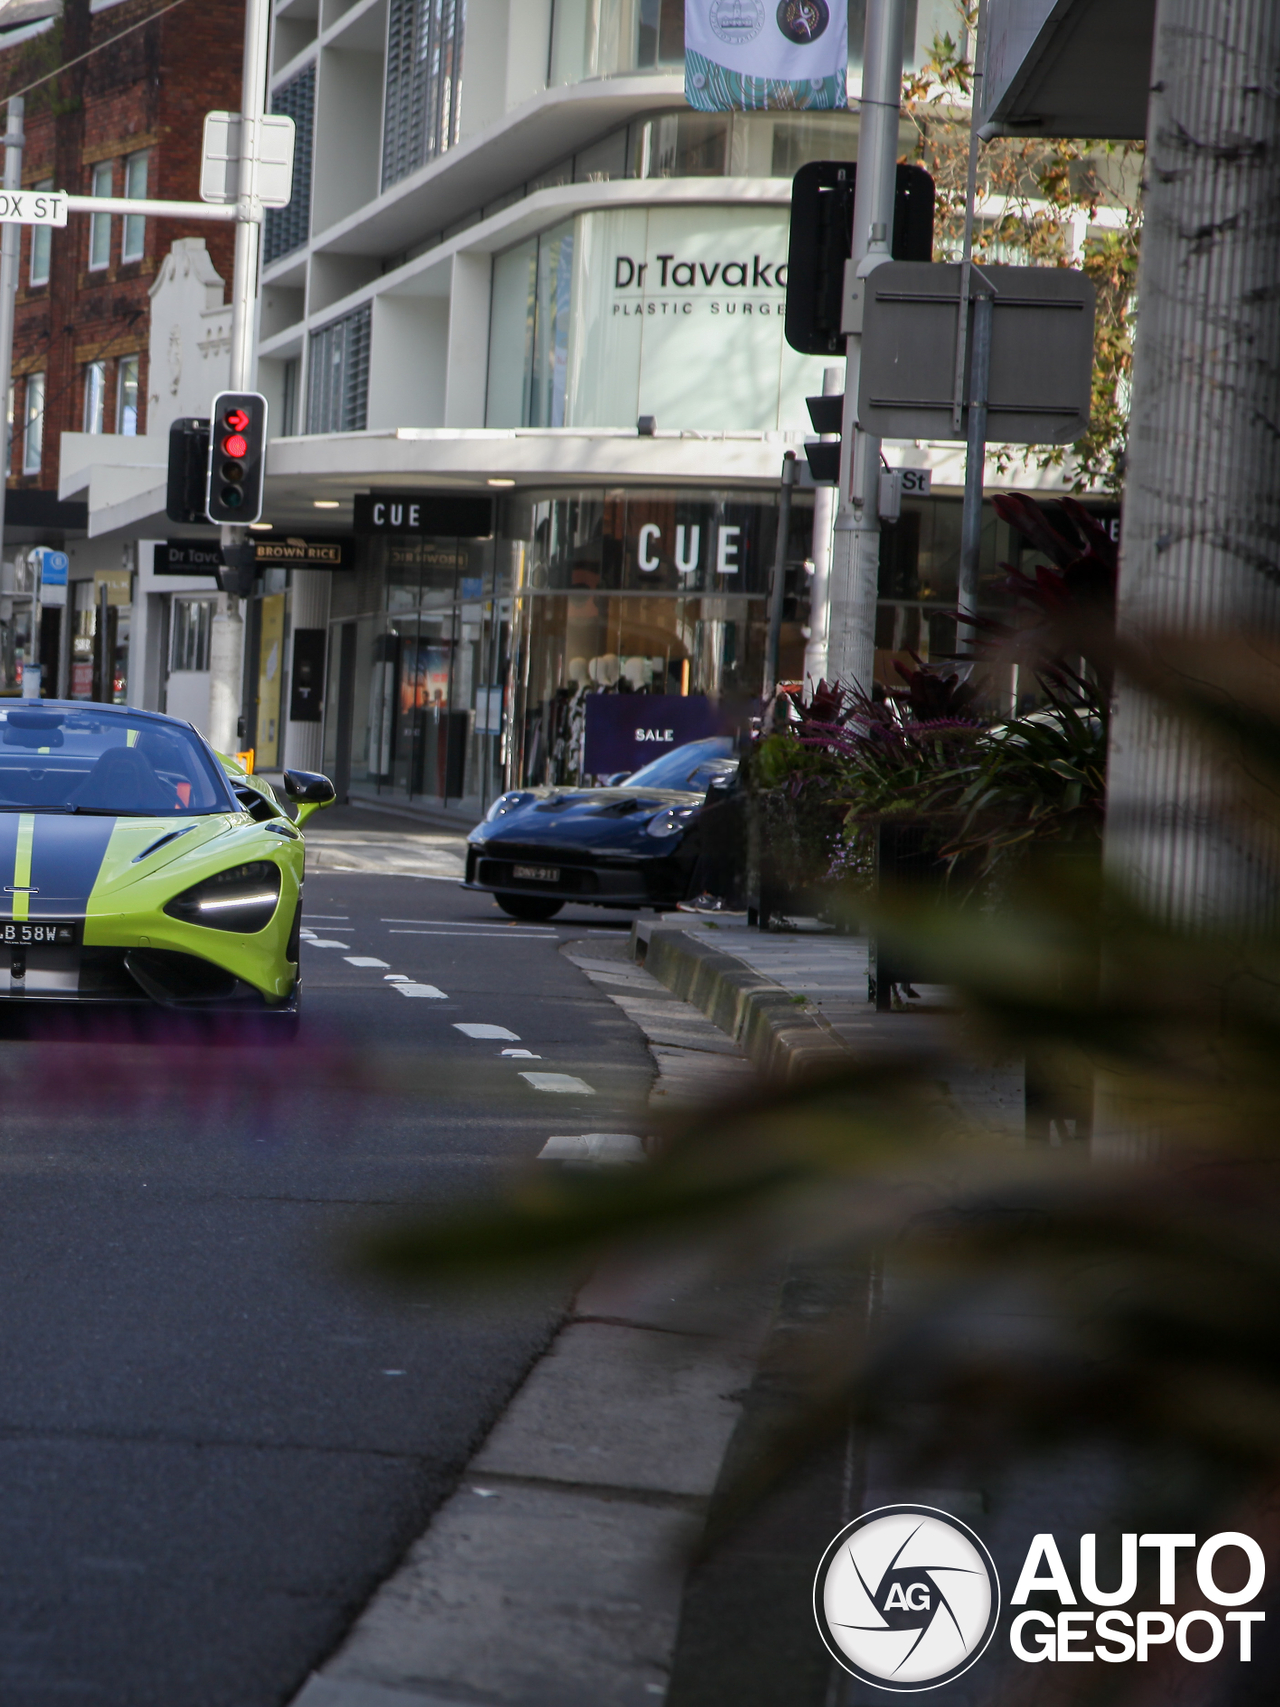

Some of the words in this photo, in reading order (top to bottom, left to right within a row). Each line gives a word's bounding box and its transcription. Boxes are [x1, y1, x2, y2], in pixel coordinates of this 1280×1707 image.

[34, 198, 62, 219] ST
[615, 256, 647, 288] Dr
[613, 302, 693, 316] PLASTIC
[902, 471, 926, 491] St
[373, 503, 420, 527] CUE
[169, 548, 185, 562] Dr
[257, 545, 305, 558] BROWN
[308, 548, 337, 560] RICE
[638, 523, 740, 573] CUE
[635, 728, 674, 741] SALE
[21, 925, 57, 941] 58W
